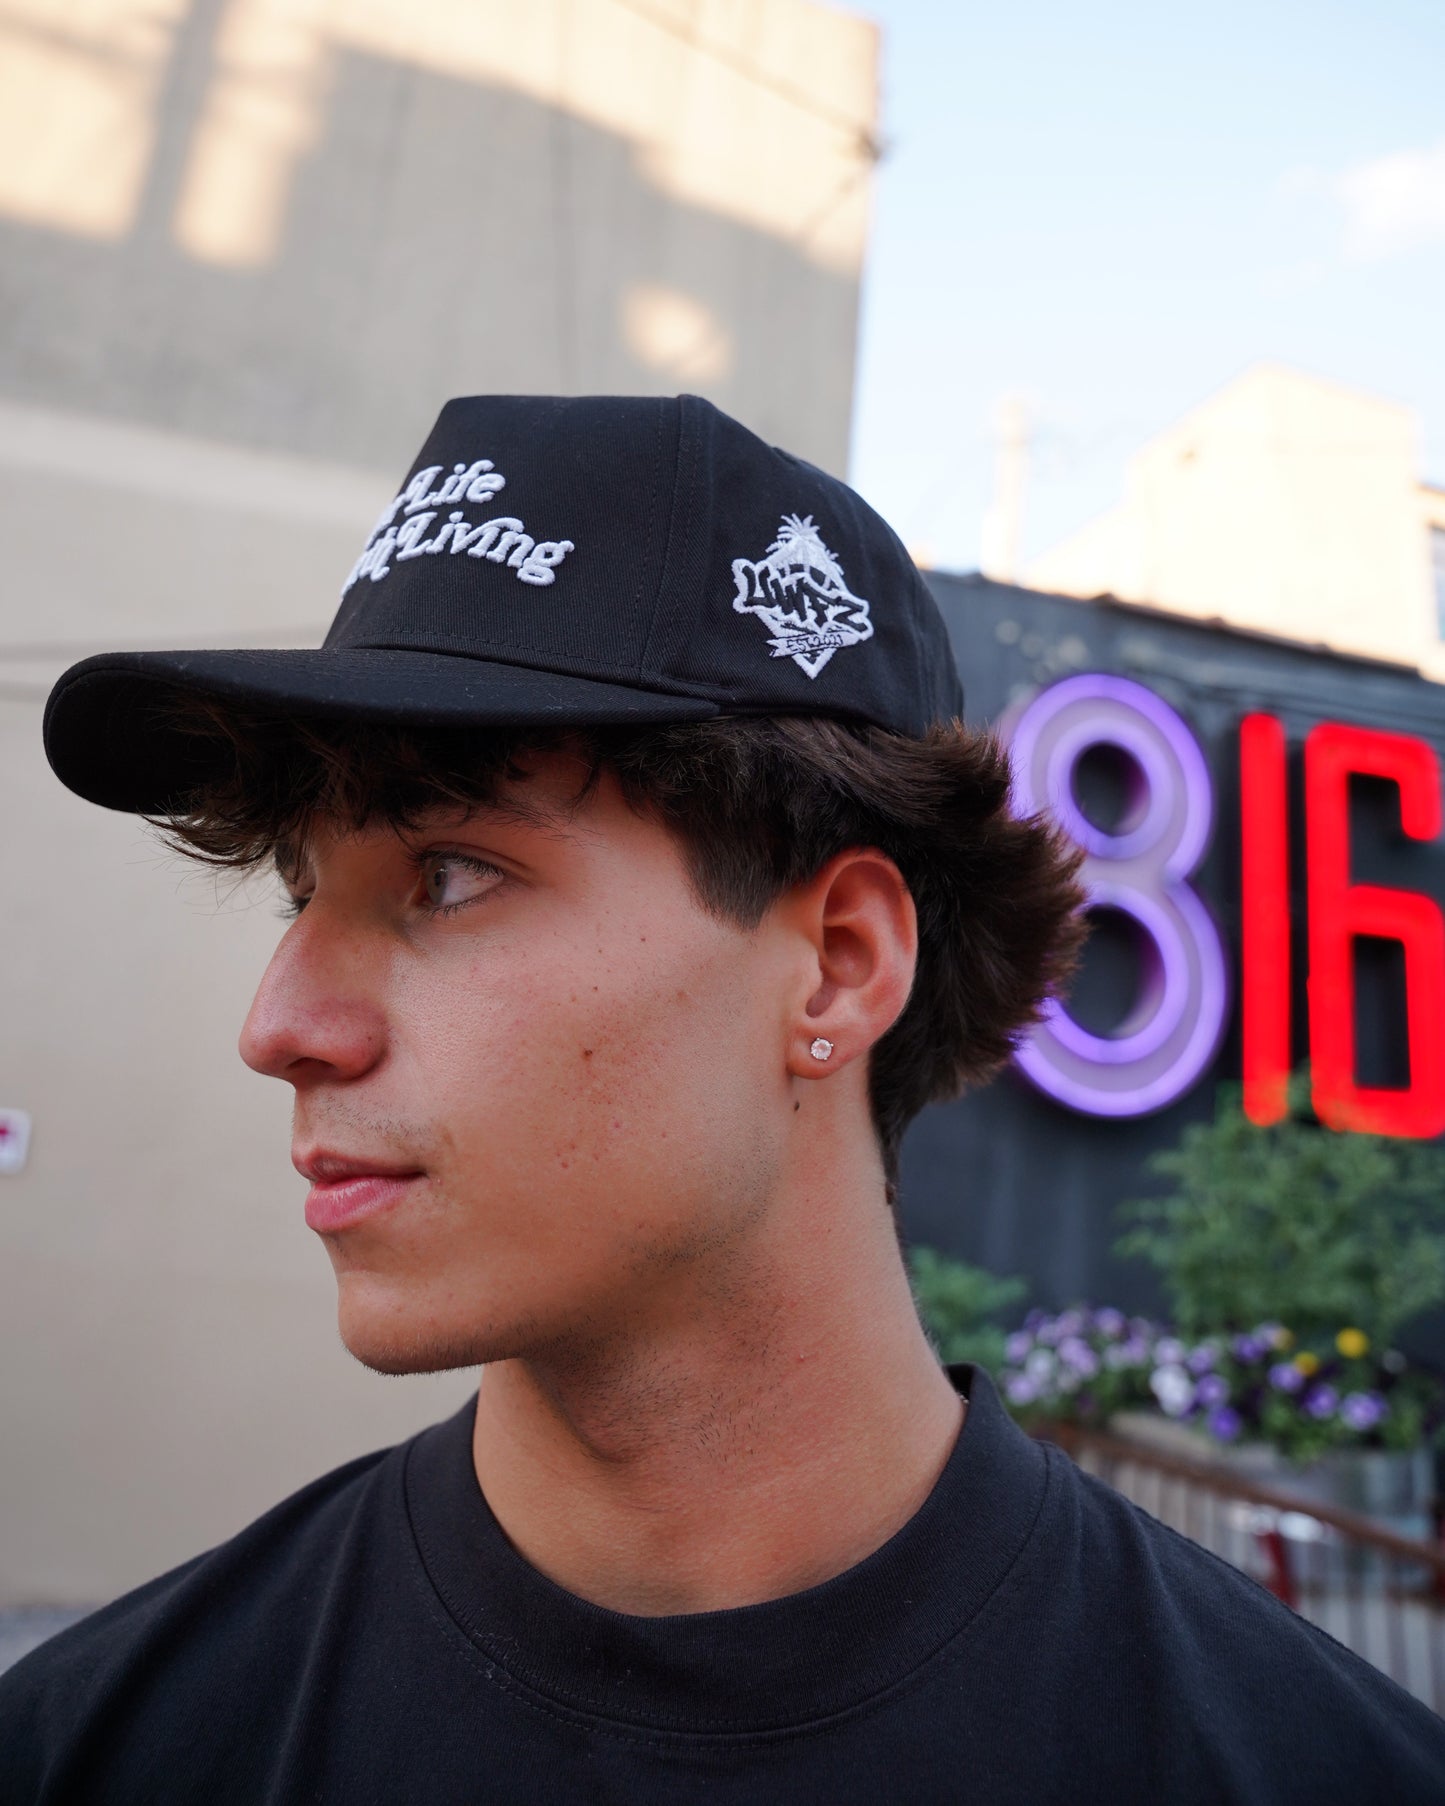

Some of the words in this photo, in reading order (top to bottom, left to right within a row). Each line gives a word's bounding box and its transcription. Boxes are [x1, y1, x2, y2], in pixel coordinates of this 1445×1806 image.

[404, 459, 506, 516] Life
[396, 511, 575, 586] Living
[1003, 673, 1445, 1139] 816
